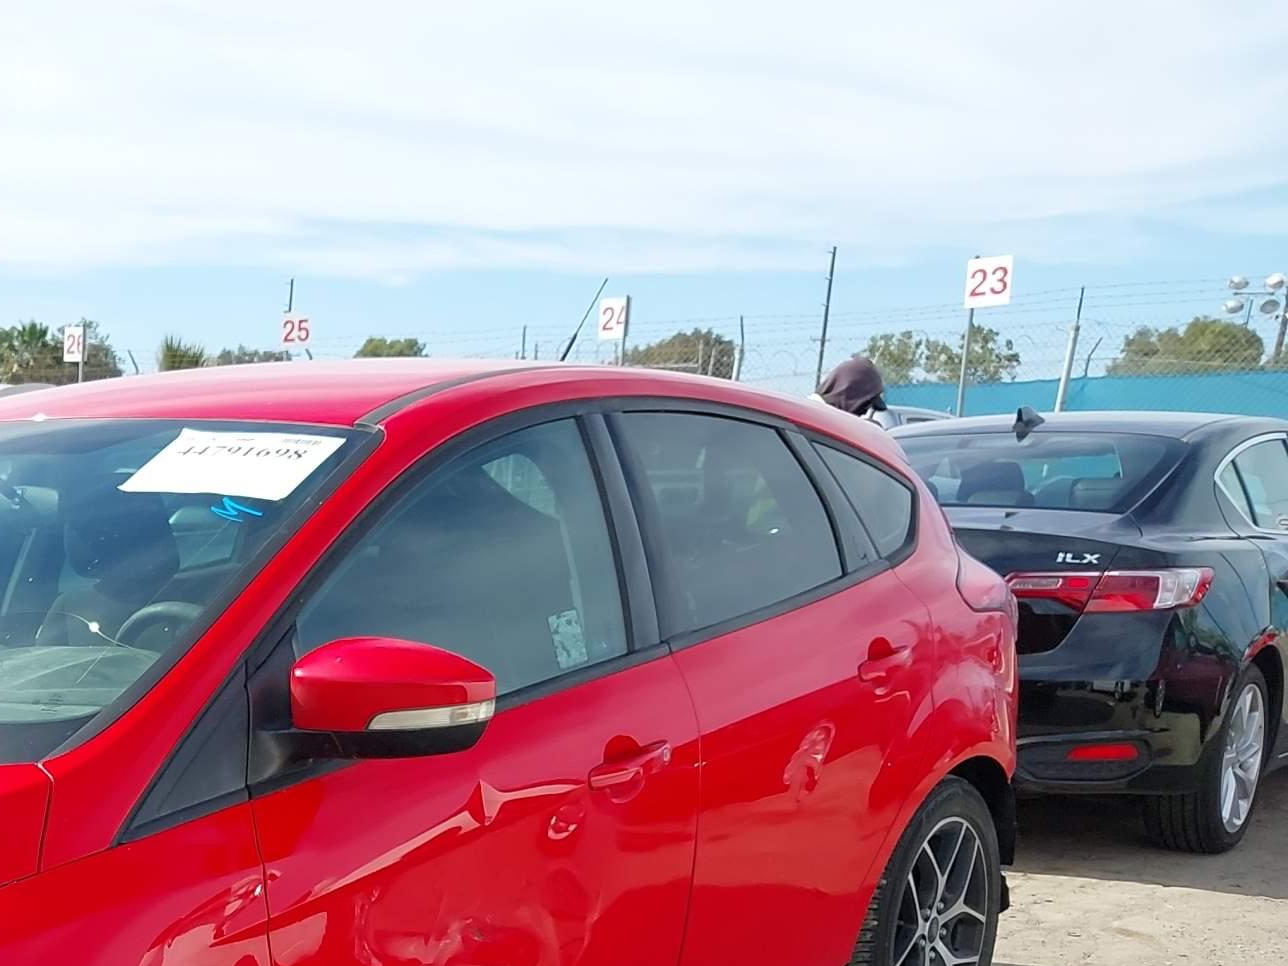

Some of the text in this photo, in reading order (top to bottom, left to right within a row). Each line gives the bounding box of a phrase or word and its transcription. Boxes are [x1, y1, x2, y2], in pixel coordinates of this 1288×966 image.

[969, 266, 1008, 297] 23
[283, 319, 310, 342] 25
[1056, 551, 1102, 564] ILX
